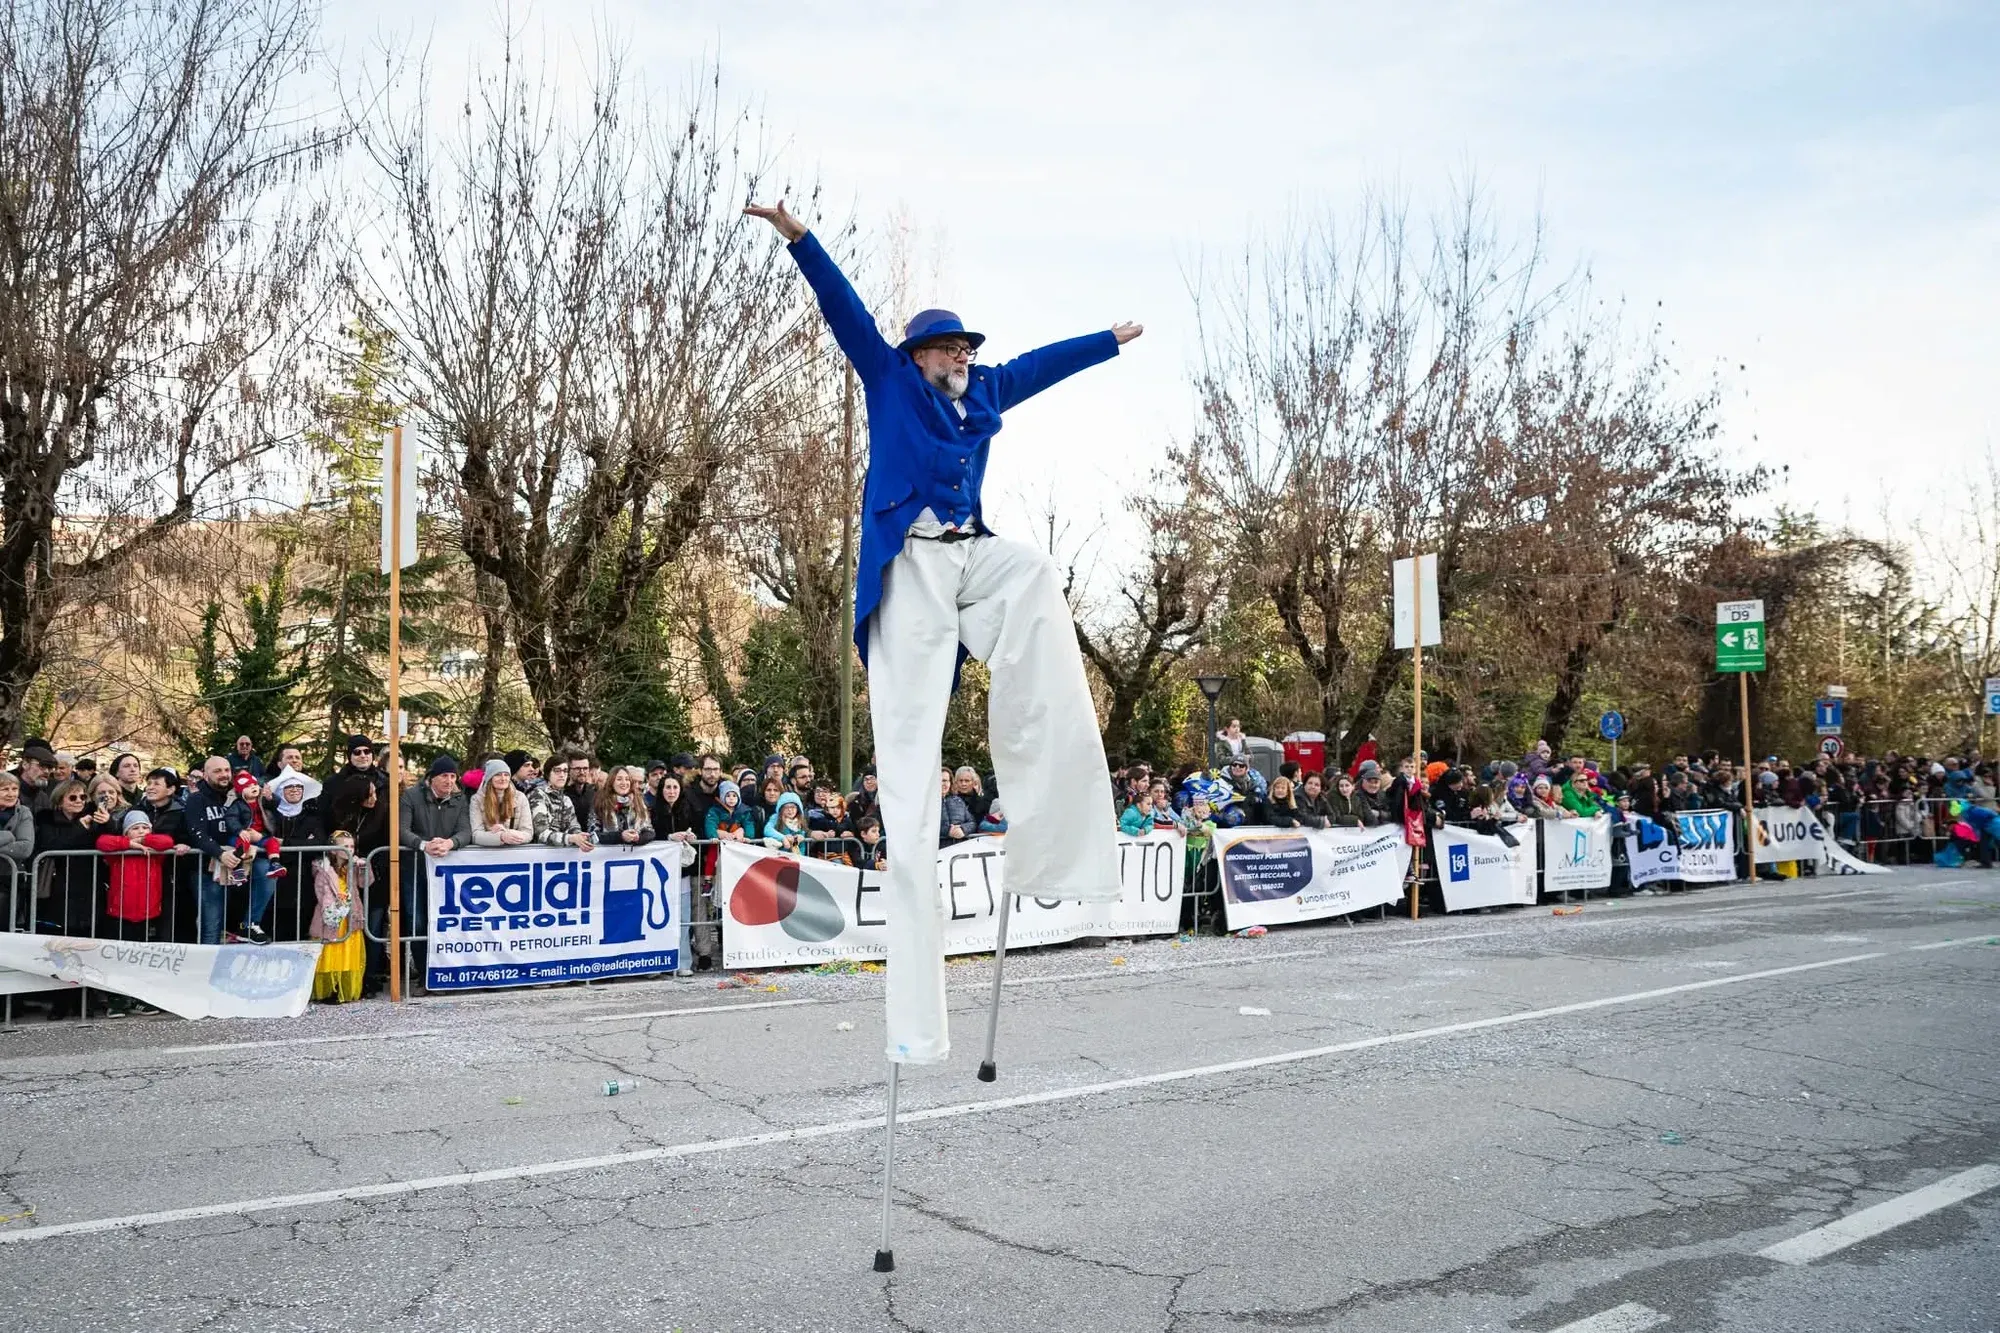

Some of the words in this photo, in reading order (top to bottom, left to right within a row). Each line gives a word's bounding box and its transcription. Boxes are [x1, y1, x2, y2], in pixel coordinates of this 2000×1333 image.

[1731, 610, 1750, 621] D9
[1823, 742, 1838, 753] 30
[1259, 863, 1288, 871] GIOVANNI
[1356, 860, 1377, 871] luce
[1474, 856, 1500, 865] Banco
[435, 860, 591, 915] Tealdi
[1304, 890, 1351, 903] unoenergy
[437, 910, 591, 933] PETROLI
[436, 941, 503, 954] PRODOTTI
[510, 935, 592, 952] PETROLIFERI
[727, 947, 781, 961] studio
[436, 972, 455, 983] Tel.
[458, 969, 519, 983] 0174/66122
[530, 965, 567, 978] E-mail:
[569, 955, 672, 976] info@tealdipetroli.it
